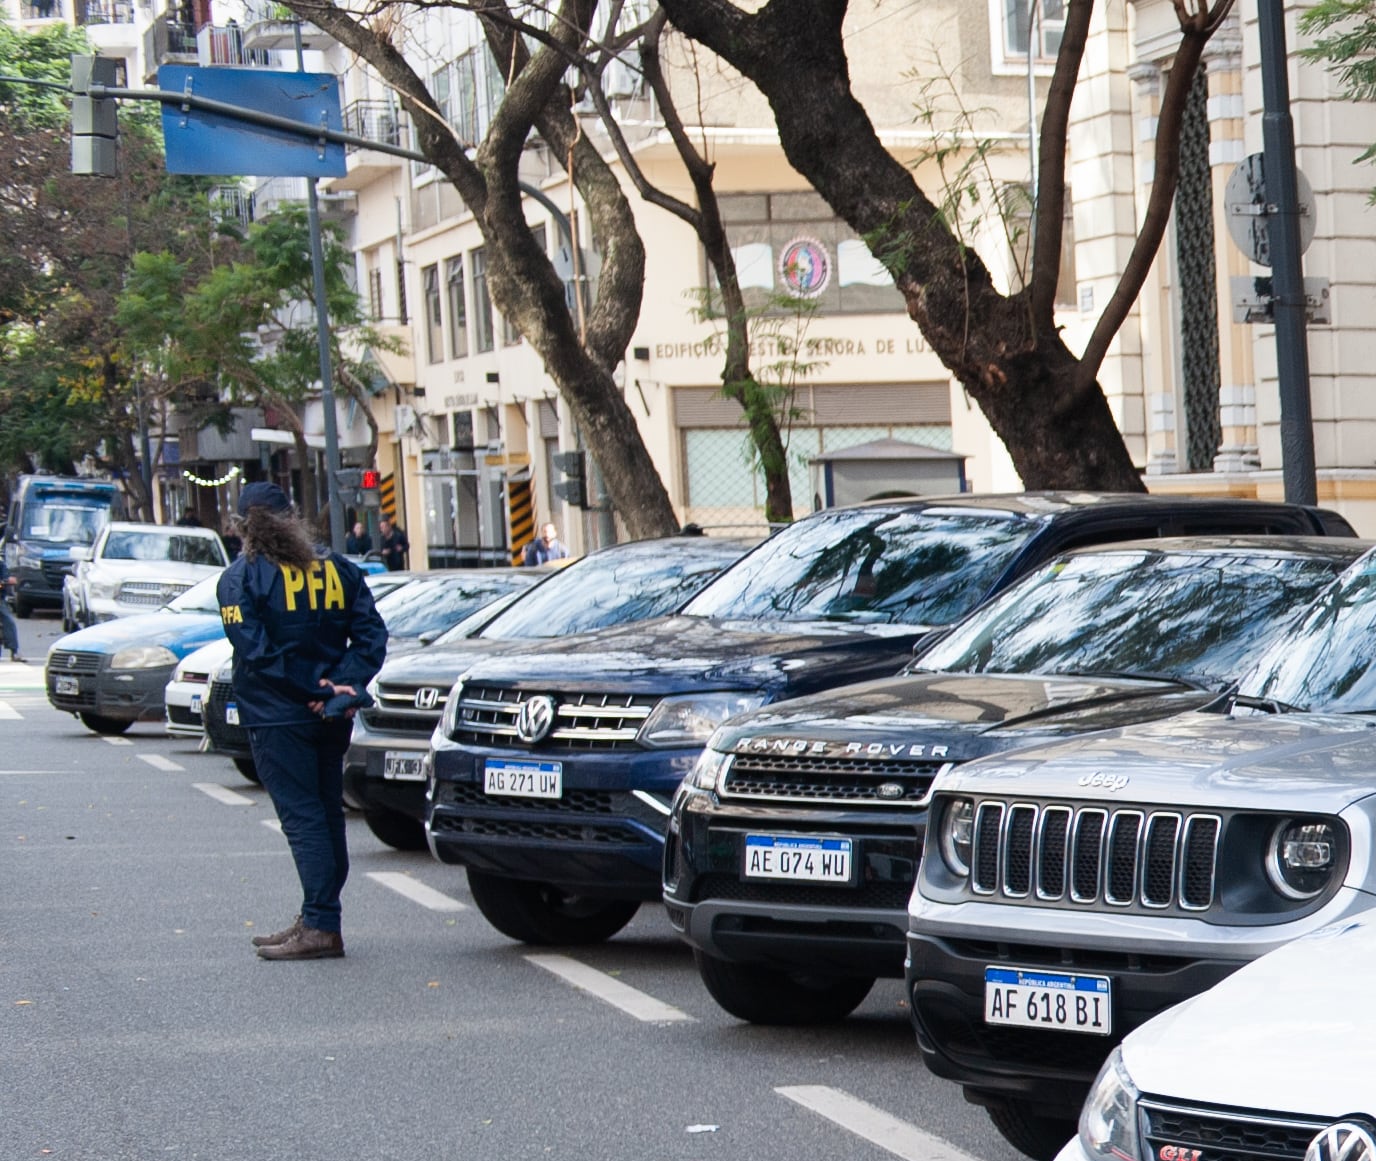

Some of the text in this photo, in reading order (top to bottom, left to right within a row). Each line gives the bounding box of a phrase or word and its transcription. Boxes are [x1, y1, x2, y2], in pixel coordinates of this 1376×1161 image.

[876, 339, 895, 355] DE
[280, 559, 345, 612] PFA
[735, 737, 950, 758] RANGE ROVER
[488, 771, 557, 793] AG 271 UW
[1077, 770, 1131, 793] Jeep
[750, 849, 845, 877] AE 074 WU
[991, 987, 1103, 1027] AF 618 BI
